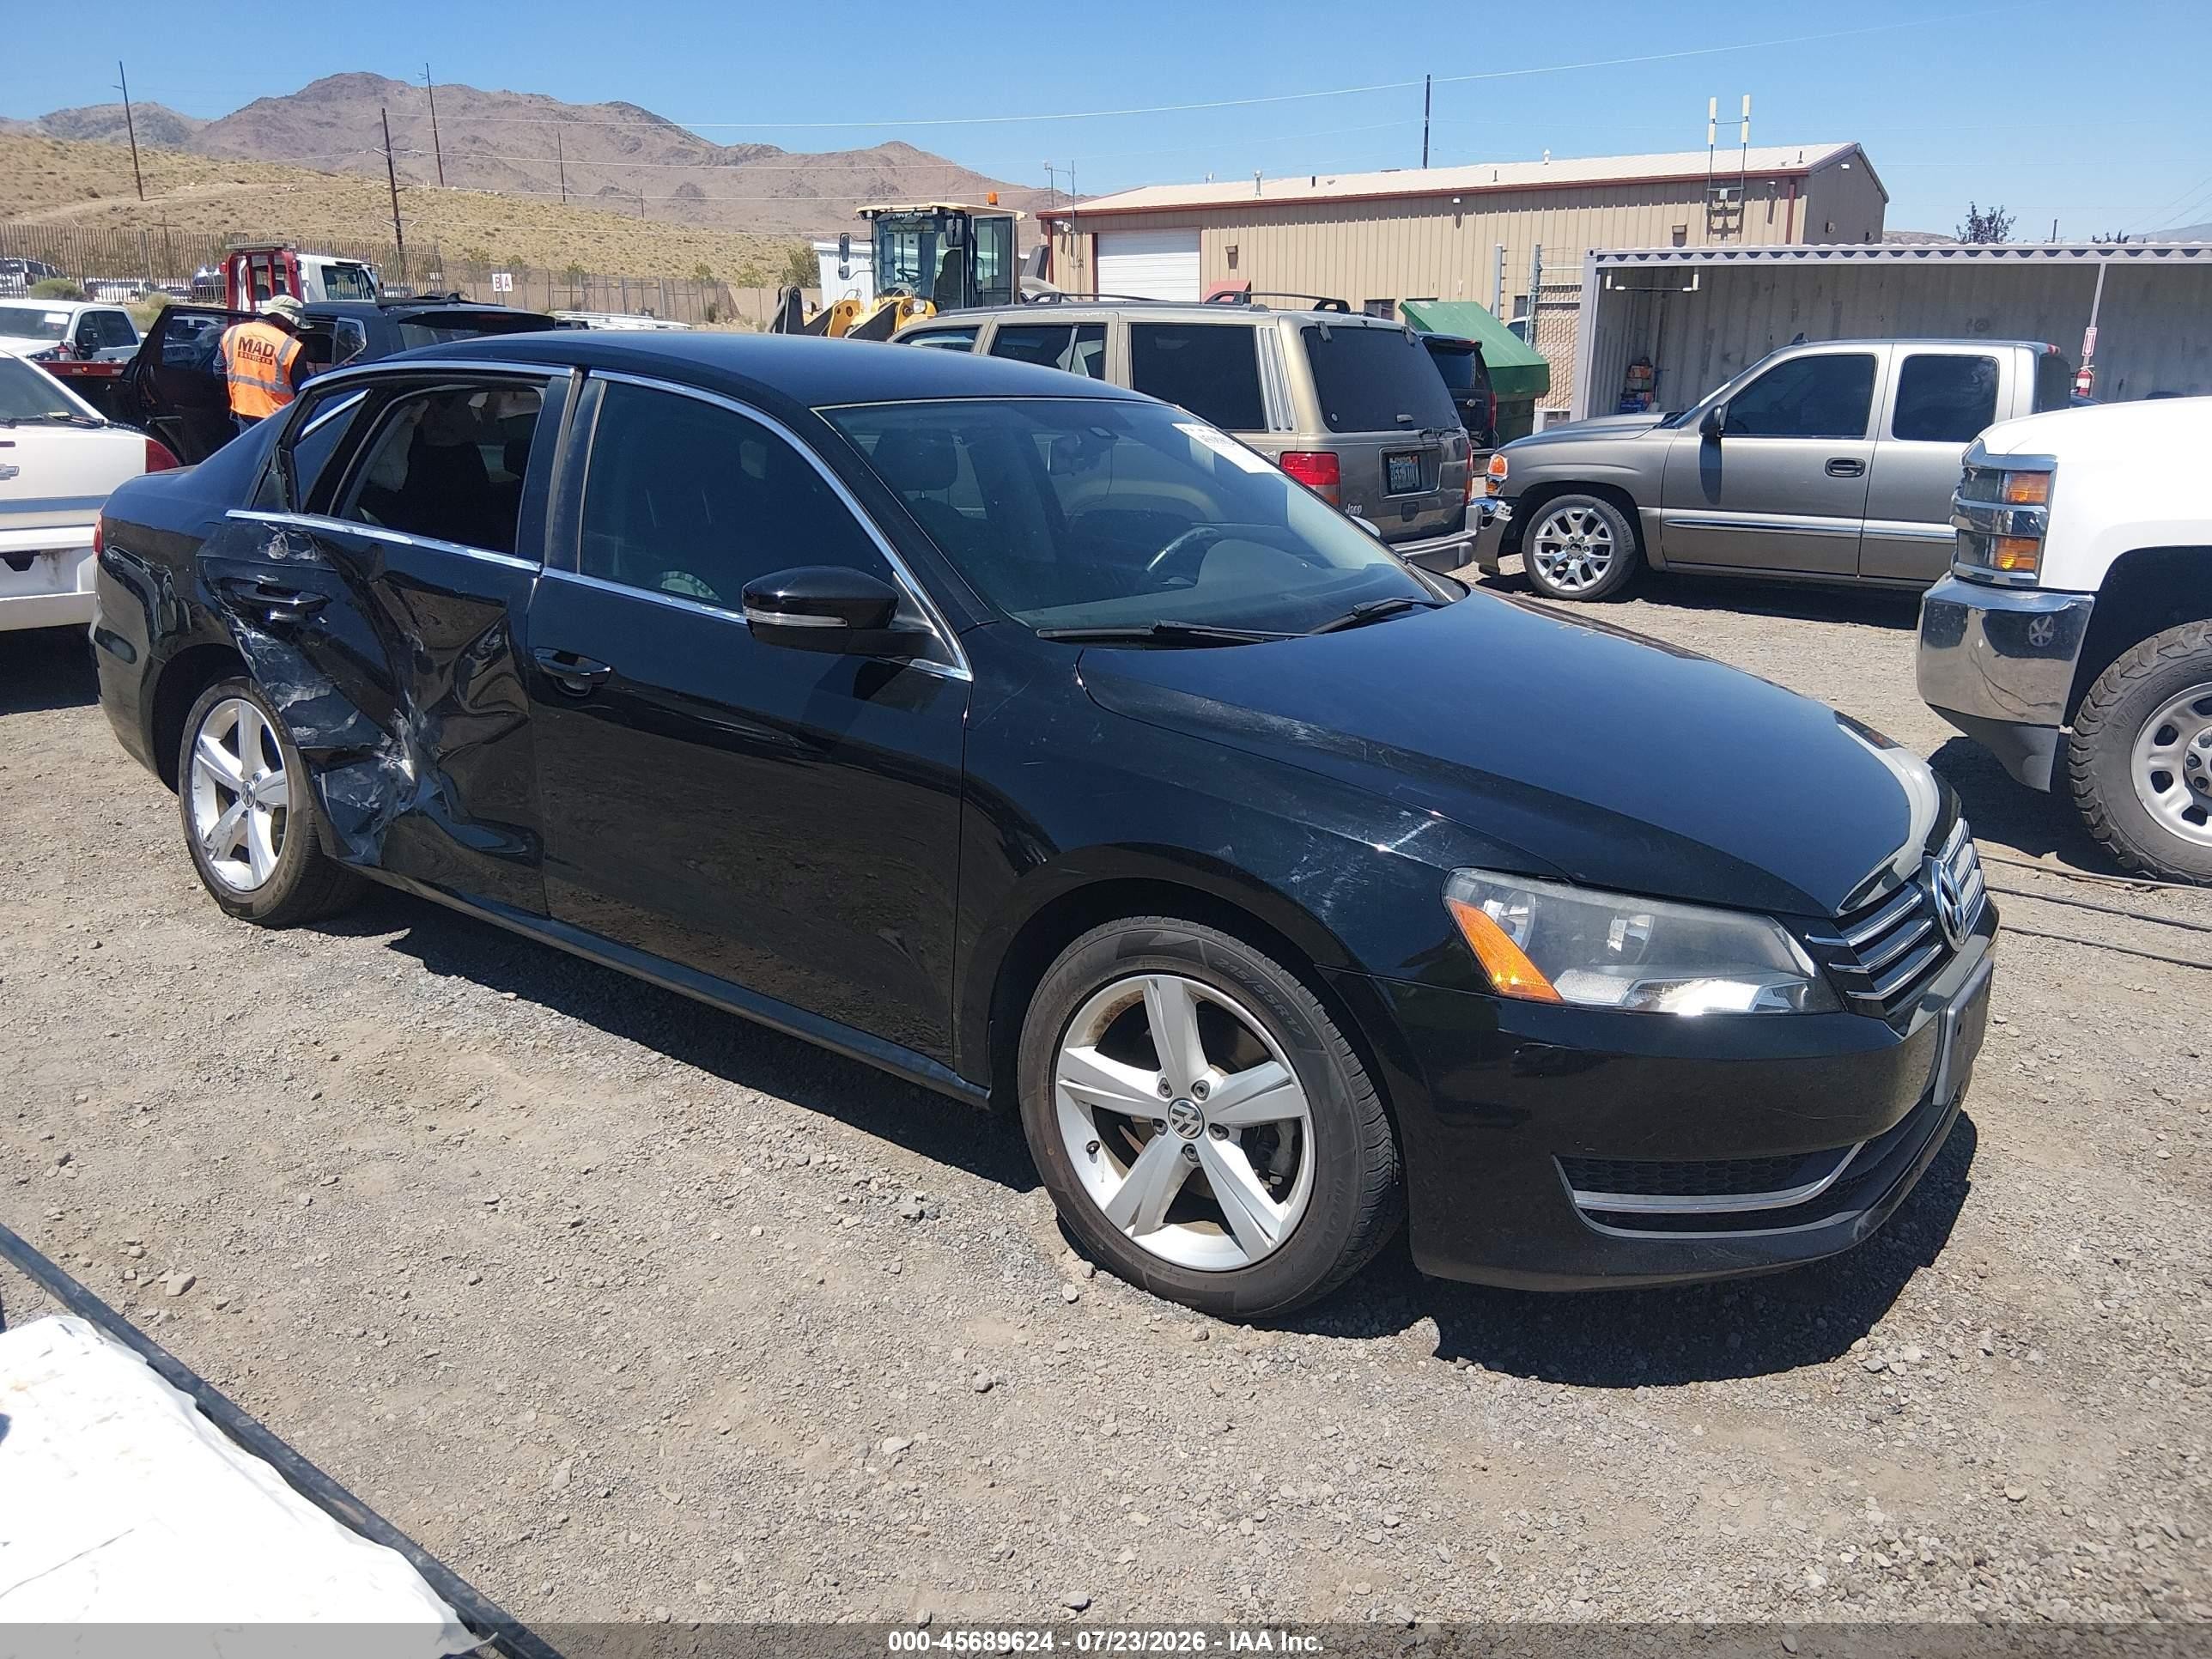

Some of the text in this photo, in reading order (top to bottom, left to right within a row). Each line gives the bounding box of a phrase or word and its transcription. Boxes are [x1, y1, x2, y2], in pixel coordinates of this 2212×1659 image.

[504, 276, 511, 289] A
[238, 336, 276, 357] MAD
[1345, 502, 1363, 515] Jeep
